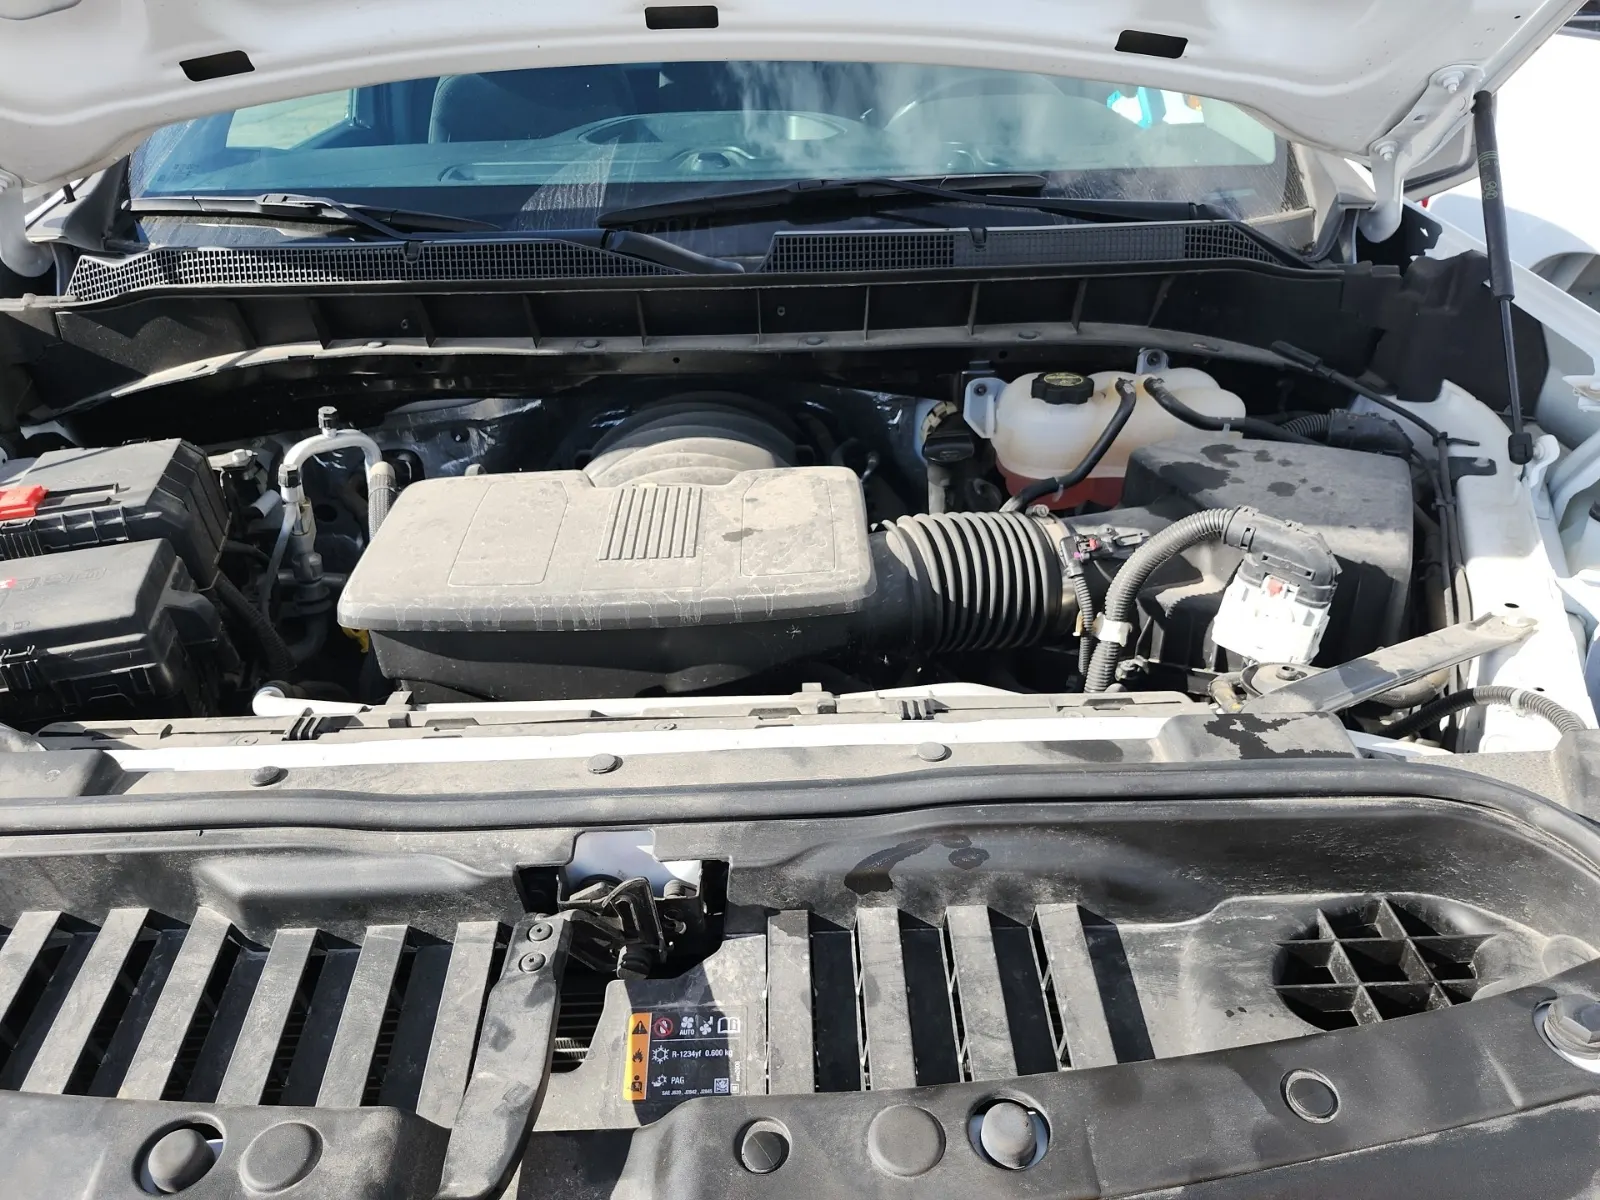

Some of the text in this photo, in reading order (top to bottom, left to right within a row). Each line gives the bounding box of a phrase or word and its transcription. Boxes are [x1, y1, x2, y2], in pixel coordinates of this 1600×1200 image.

[672, 1048, 733, 1058] R-1234yf 0.600 kg
[670, 1076, 685, 1084] PAG
